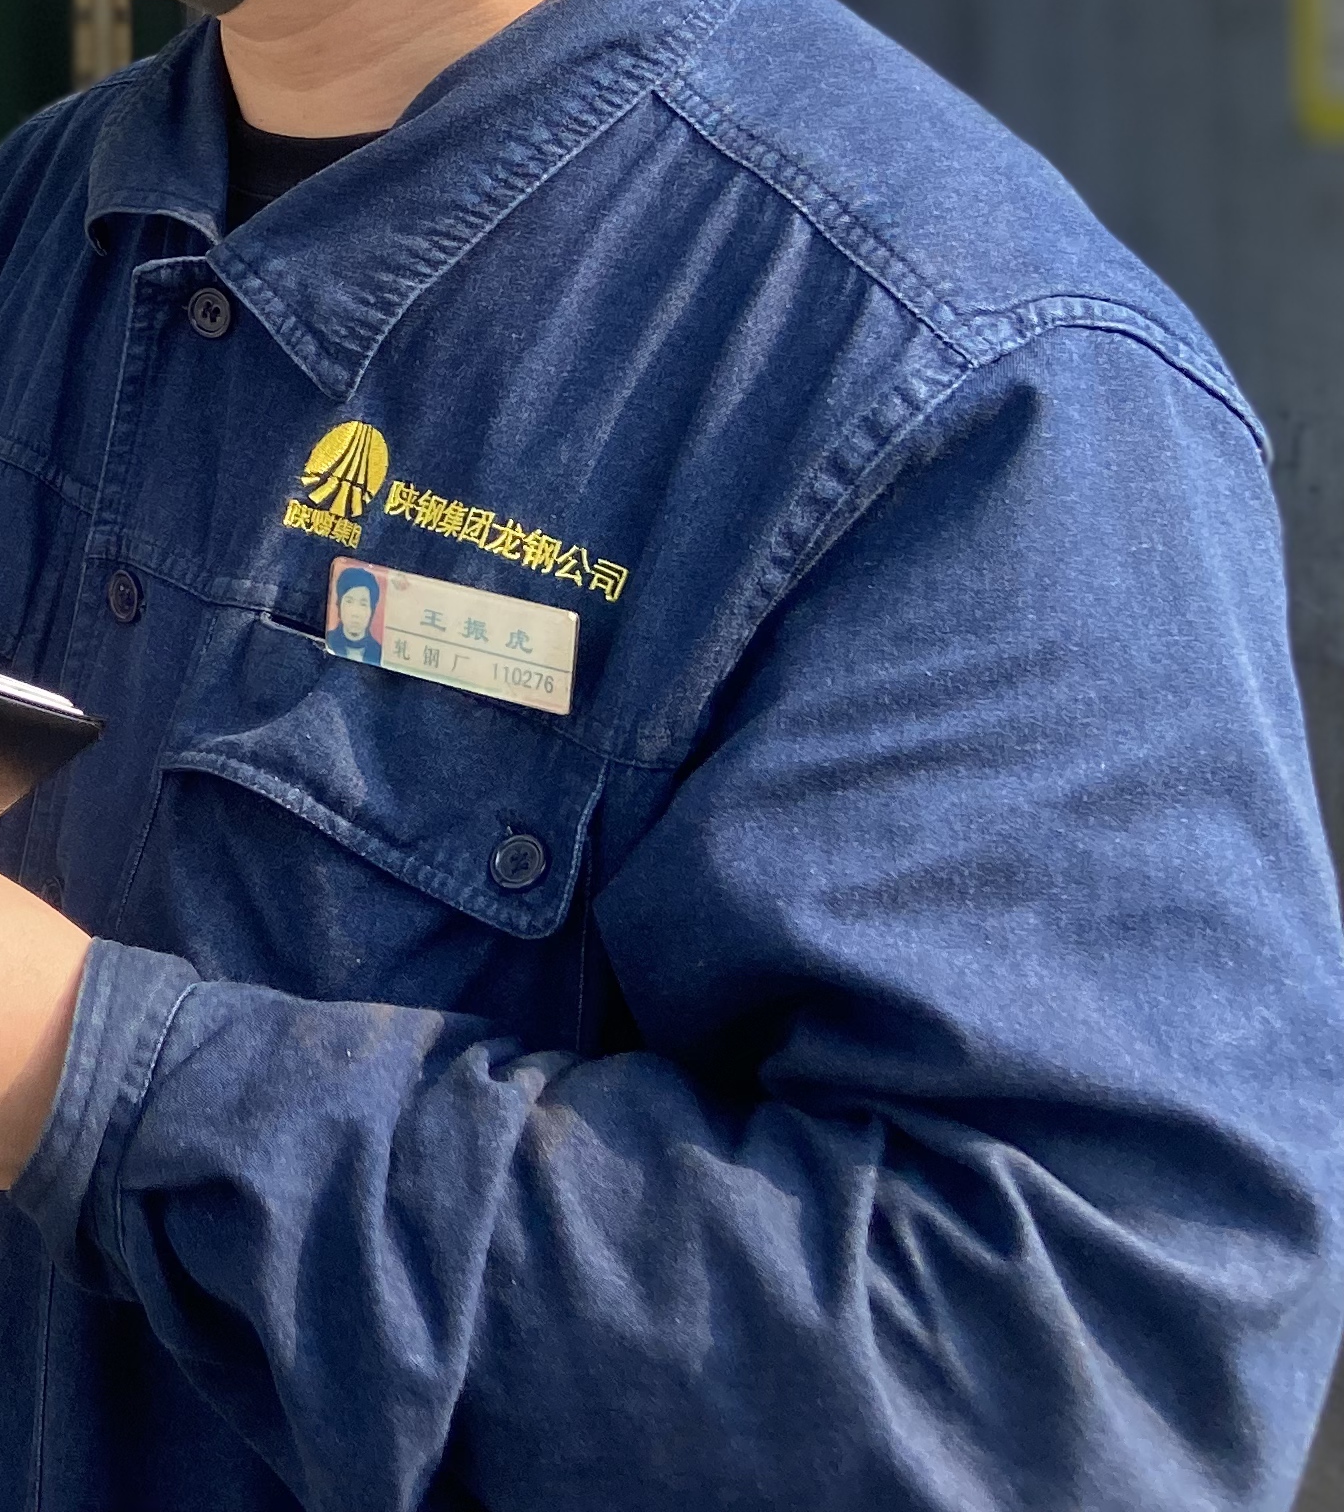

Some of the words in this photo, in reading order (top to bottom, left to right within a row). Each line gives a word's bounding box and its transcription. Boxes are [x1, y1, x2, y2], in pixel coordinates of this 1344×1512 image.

[384, 481, 629, 602] 陕钢集团龙钢公司
[419, 608, 533, 654] 王振虎
[393, 638, 470, 672] 轧钢厂
[492, 662, 554, 694] 110276
